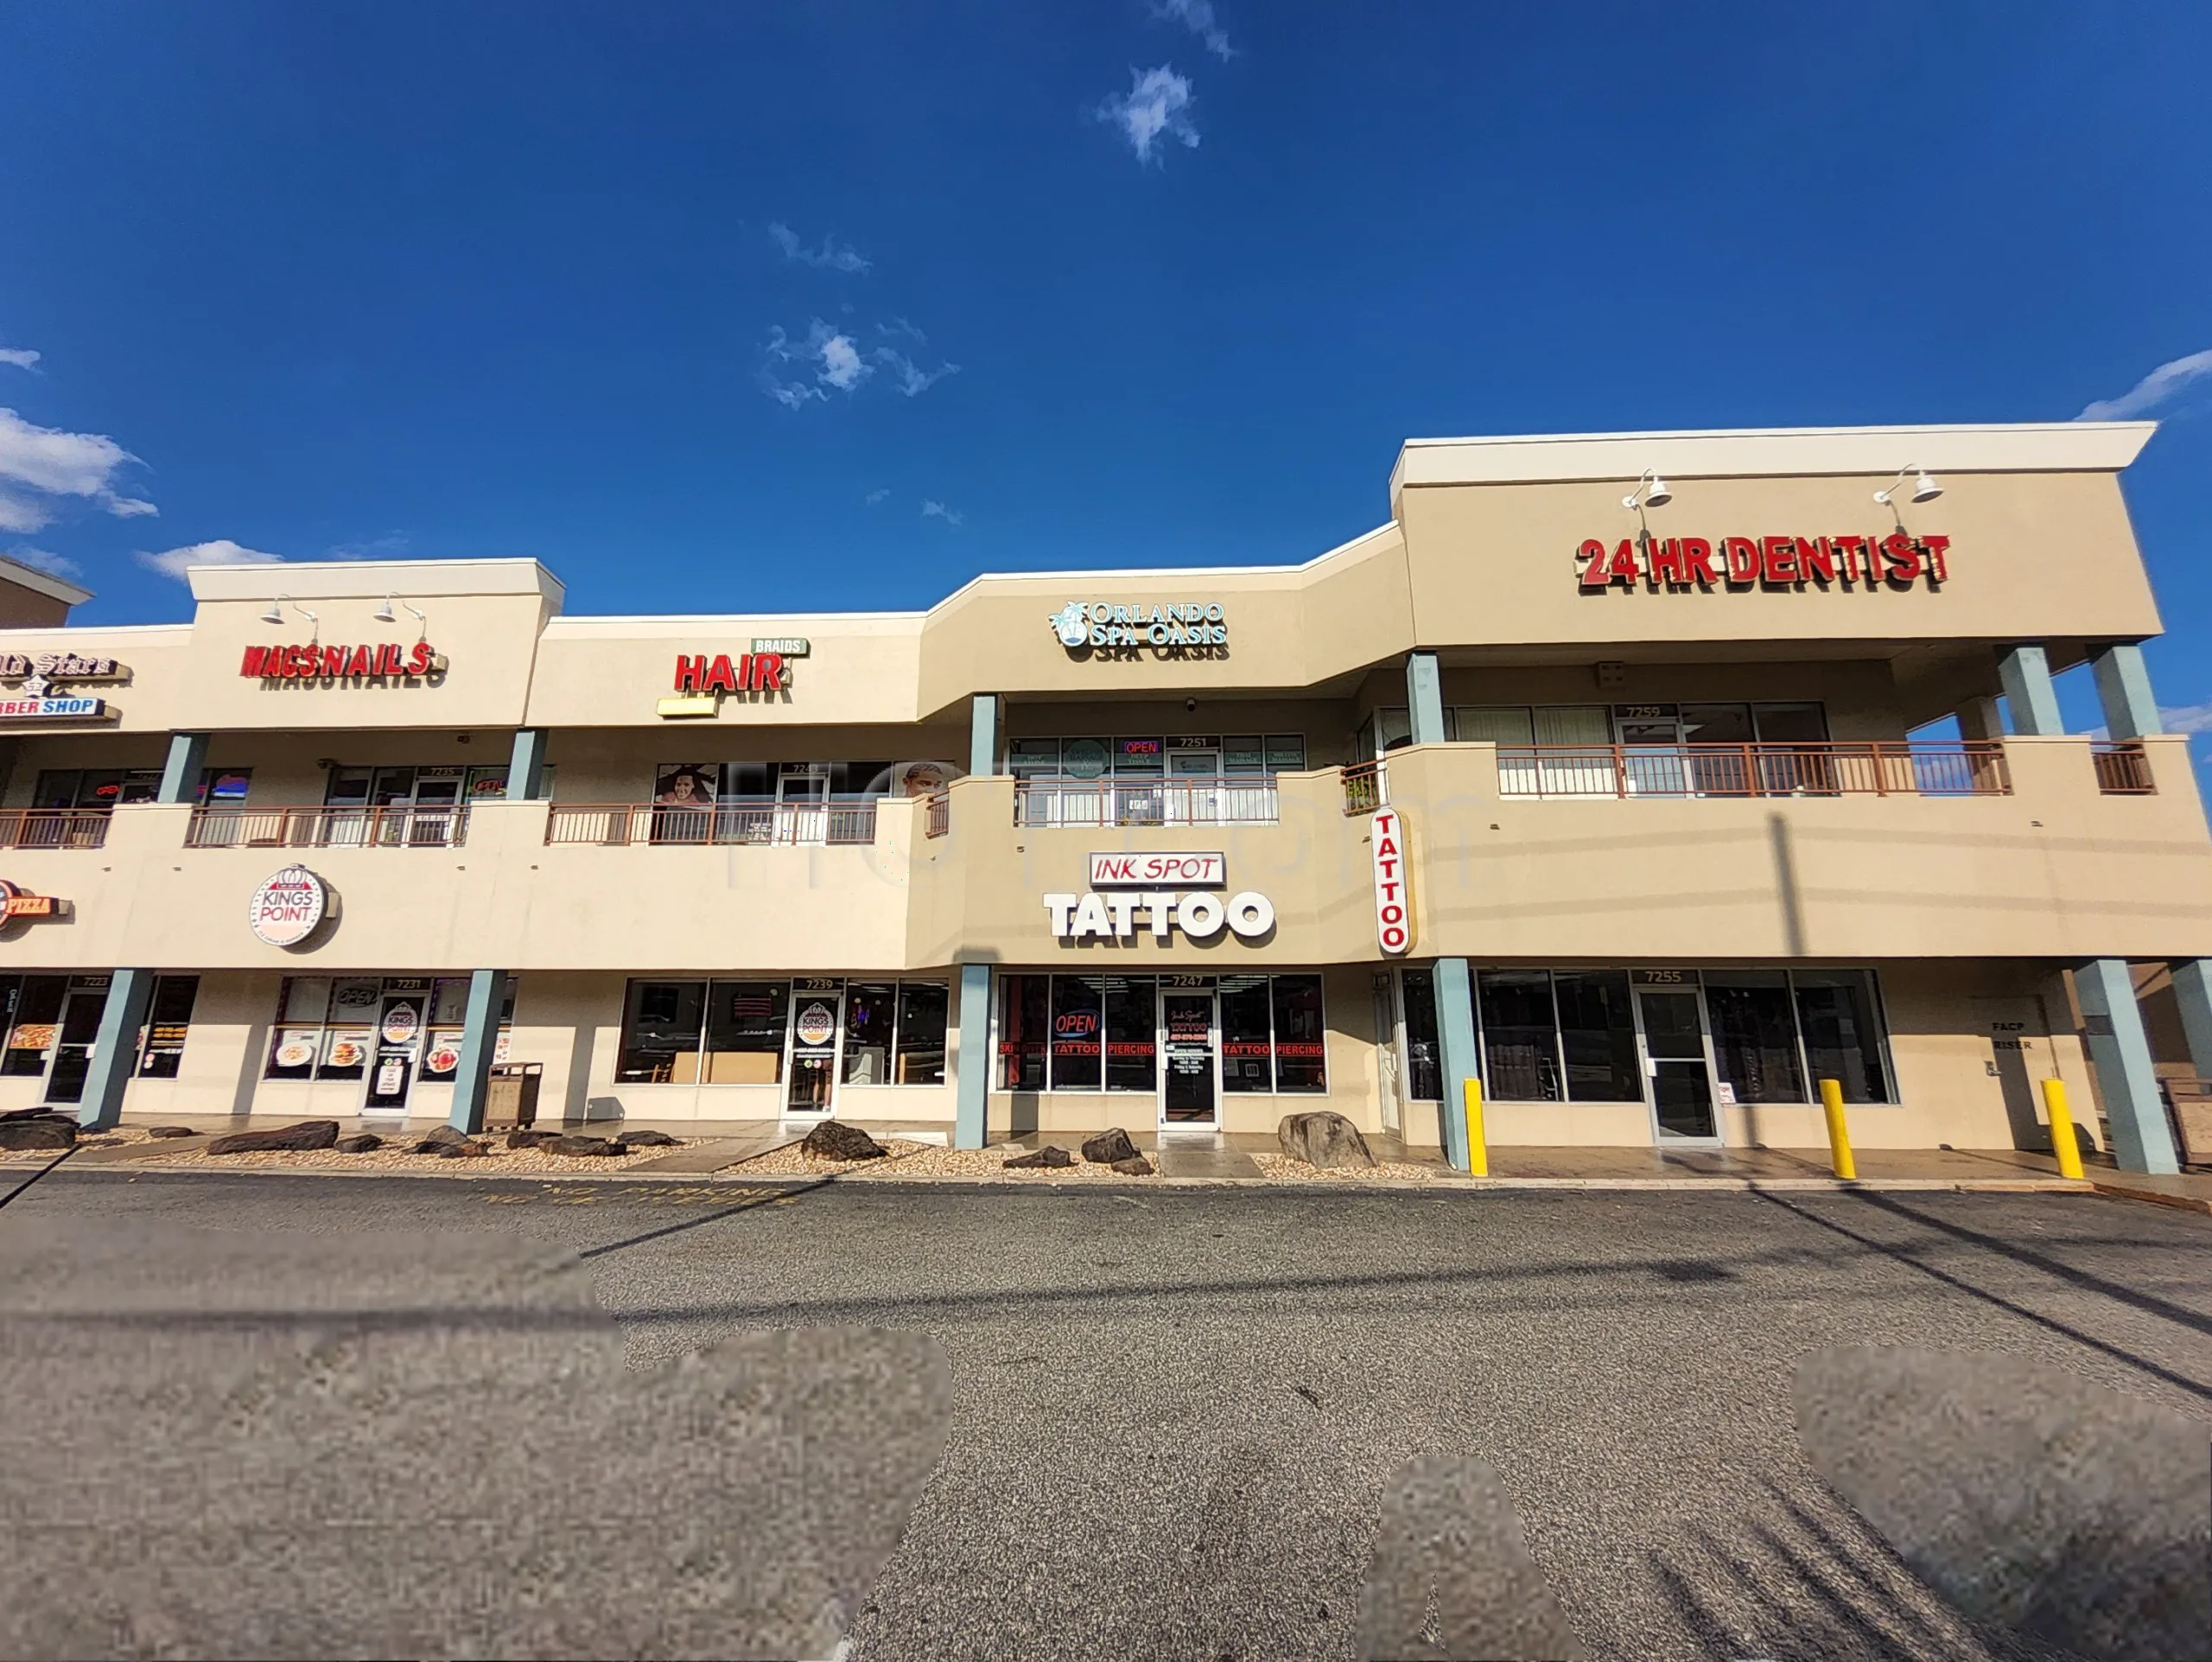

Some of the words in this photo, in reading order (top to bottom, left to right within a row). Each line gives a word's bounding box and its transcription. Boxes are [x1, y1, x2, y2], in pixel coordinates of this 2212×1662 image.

[1580, 538, 1639, 585] 24
[1645, 537, 1719, 584] HR
[1725, 533, 1950, 583] DENTIST
[1090, 602, 1224, 623] ORLANDO
[1090, 624, 1138, 646] SPA
[1147, 623, 1226, 645] OASIS
[756, 639, 800, 653] BRAIDS
[674, 654, 781, 691] HAIR
[43, 700, 92, 713] SHOP
[1626, 707, 1660, 718] 7259
[1126, 742, 1156, 753] OPEN
[1180, 738, 1206, 748] 7251
[431, 767, 454, 776] 7235
[1094, 858, 1137, 879] INK
[1144, 858, 1218, 879] SPOT
[1375, 814, 1405, 946] TATTOO
[262, 891, 313, 906] KINGS
[6, 898, 50, 913] PIZZA
[259, 907, 311, 921] POINT
[1043, 891, 1274, 936] TATTOO
[1173, 976, 1203, 985] 7247
[1645, 971, 1681, 983] 7255
[397, 979, 421, 989] 7231
[806, 980, 833, 990] 7239
[388, 1016, 413, 1024] KINGS
[1056, 1015, 1096, 1032] OPEN
[1993, 1022, 2024, 1031] FACP
[1054, 1044, 1100, 1054] TATTOO
[1108, 1044, 1154, 1054] PIERCING
[1224, 1045, 1269, 1054] TATTOO
[1276, 1045, 1323, 1054] PIERCING
